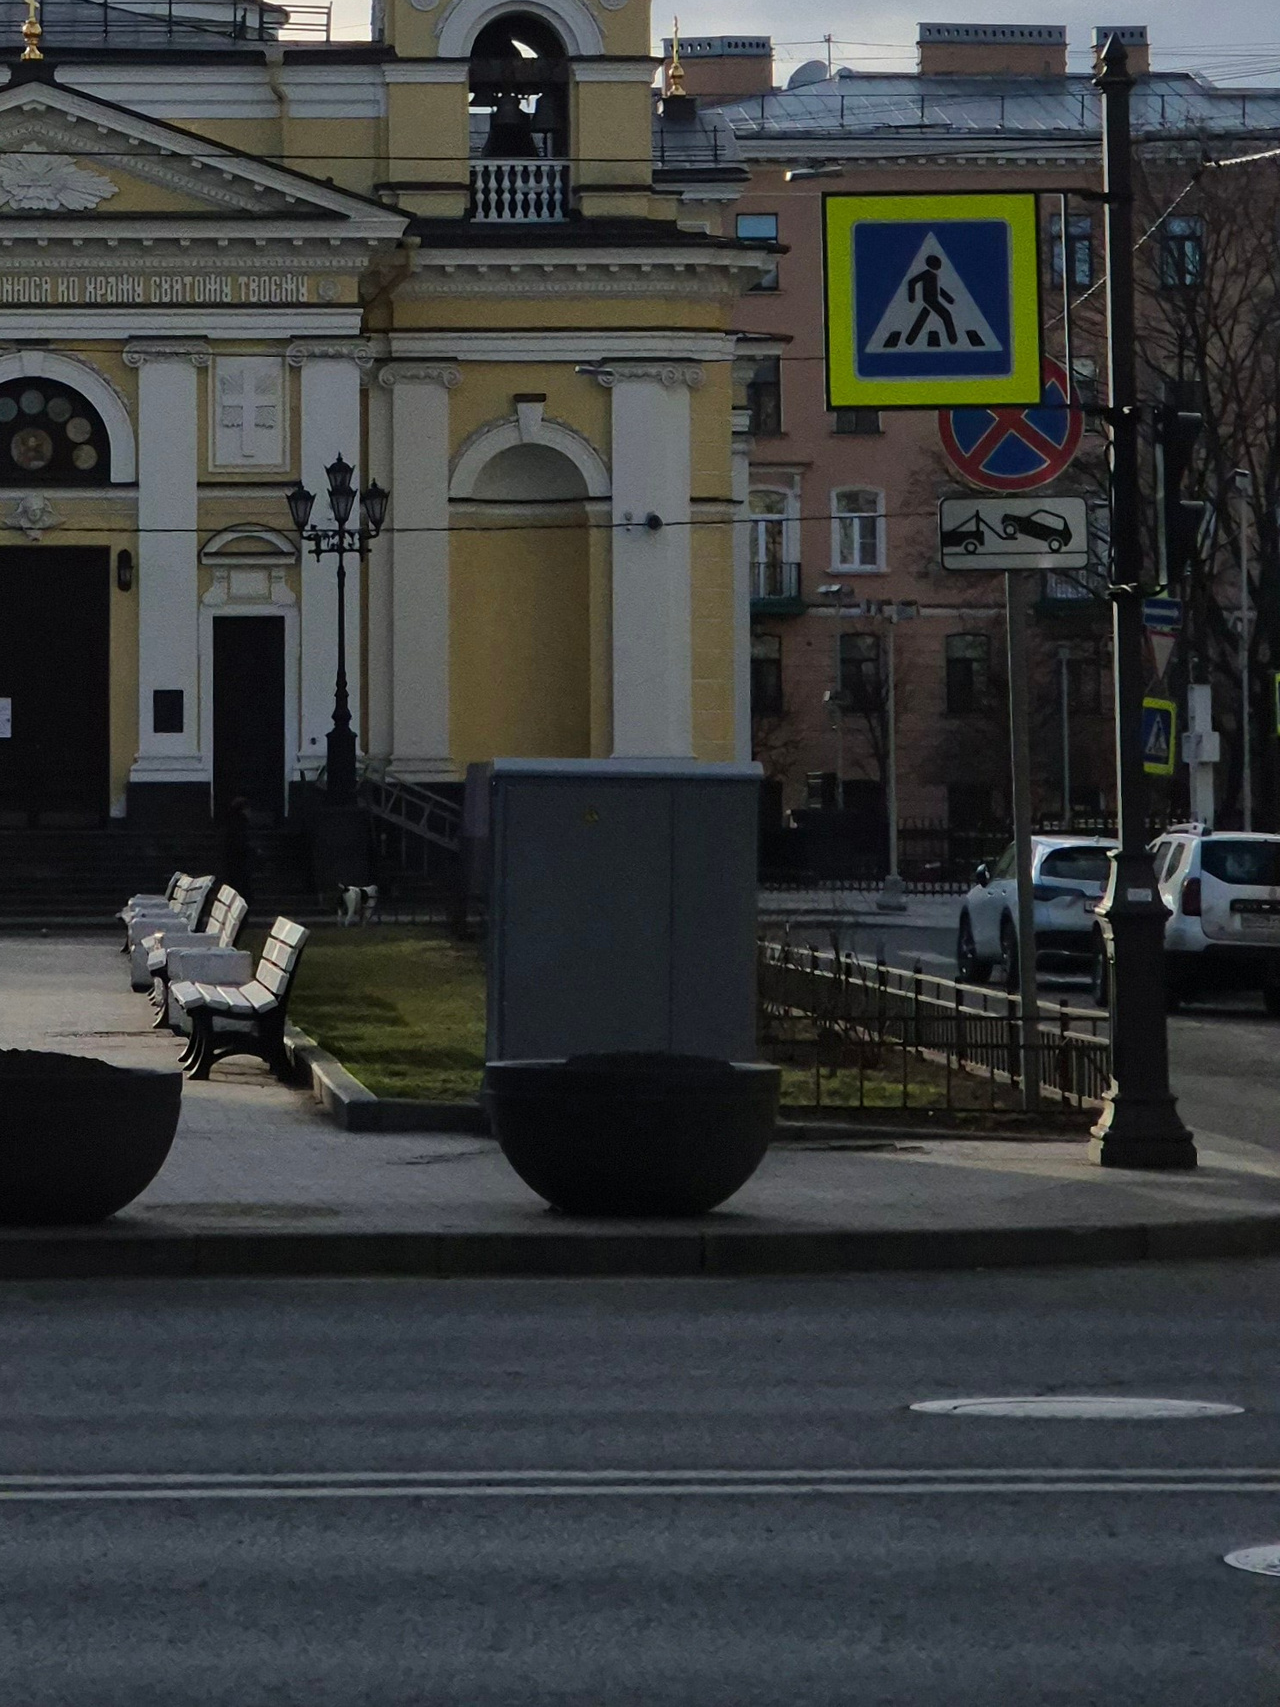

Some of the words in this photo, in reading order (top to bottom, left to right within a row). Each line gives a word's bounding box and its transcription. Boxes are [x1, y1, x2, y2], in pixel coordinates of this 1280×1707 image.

[58, 276, 78, 302] КО
[85, 274, 143, 302] ХРАМУ
[151, 274, 232, 302] СВЯТОМУ
[238, 274, 308, 302] ТВОЕМУ
